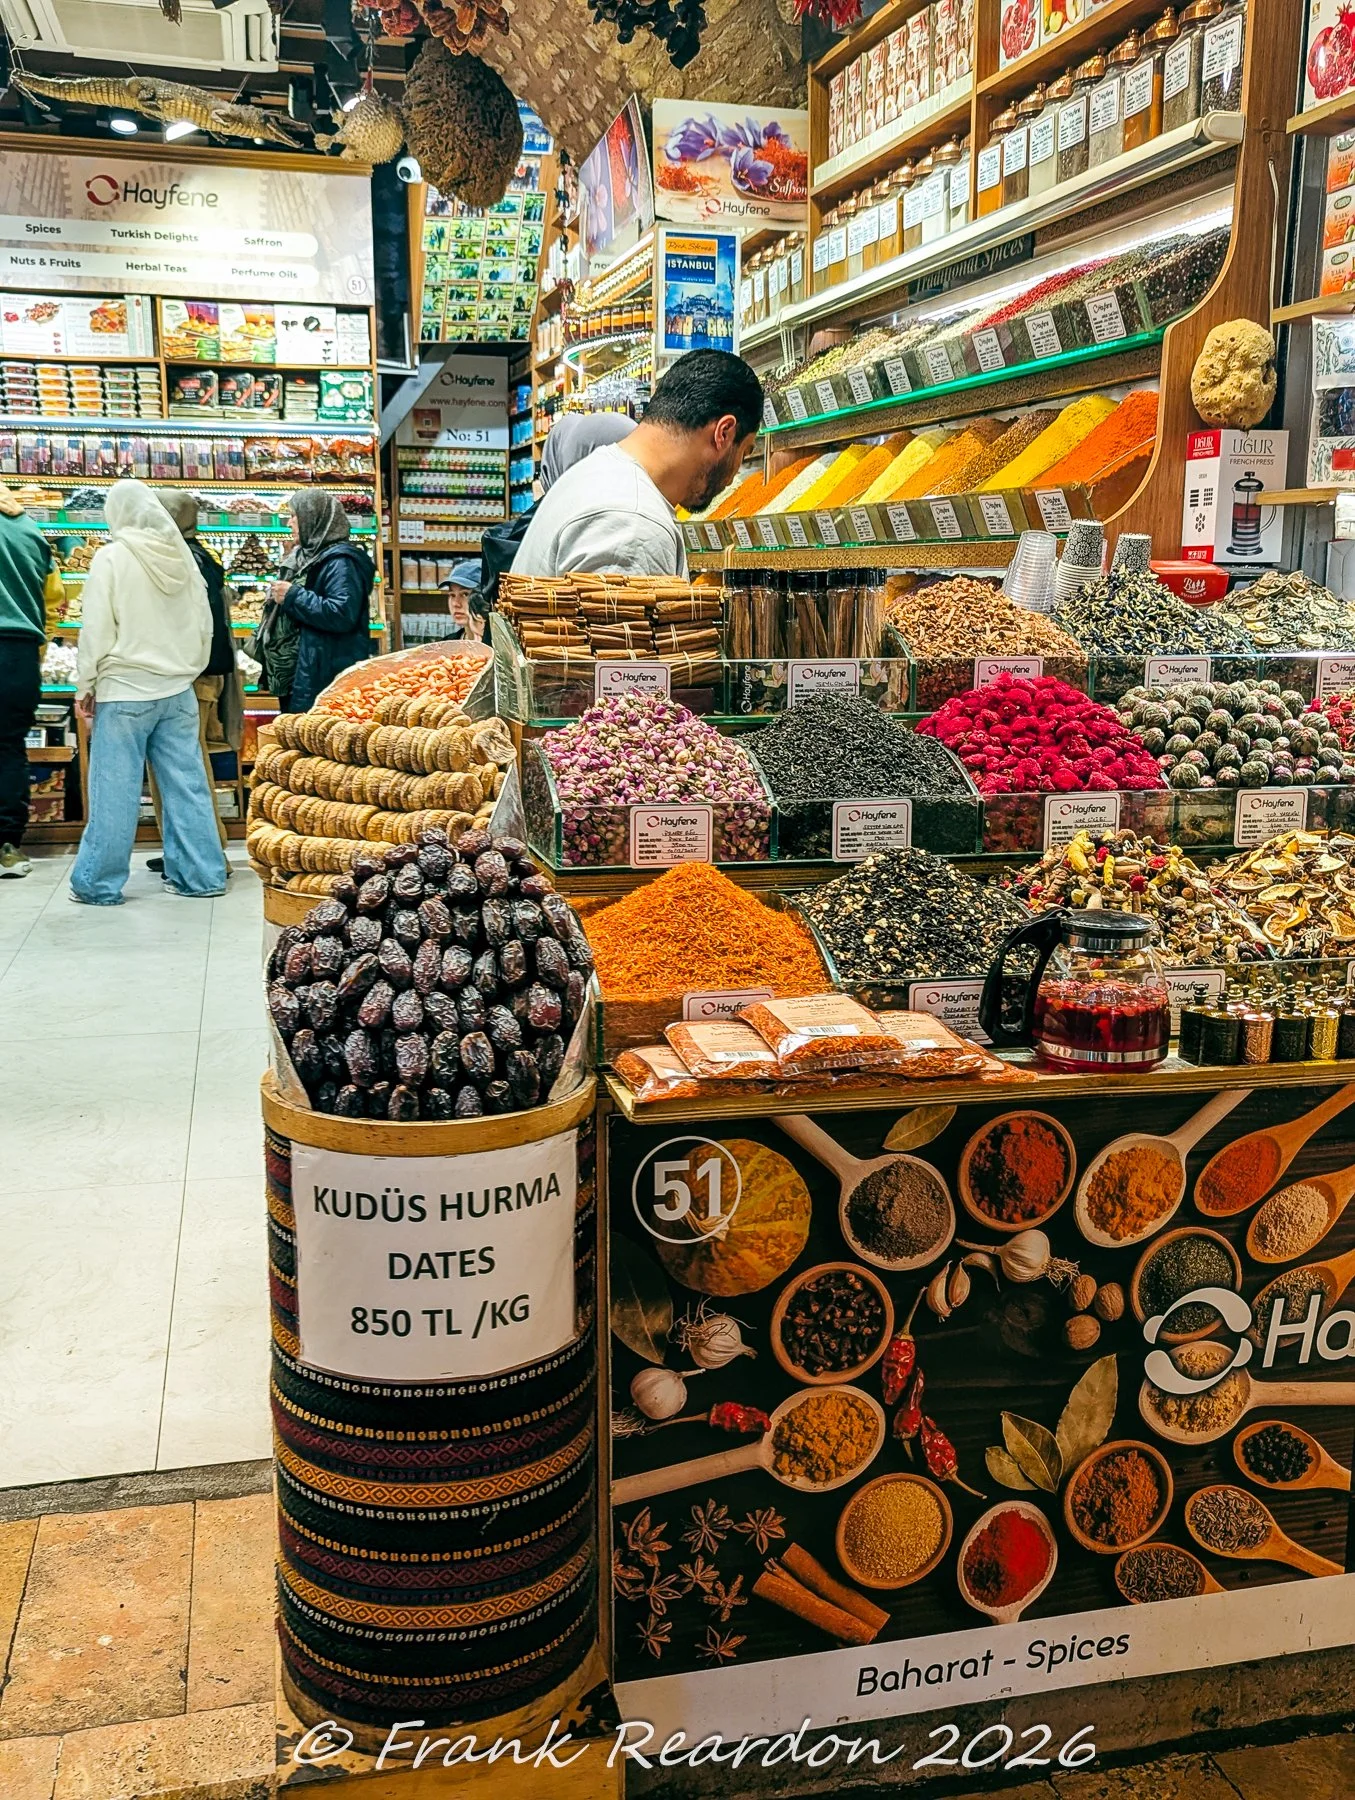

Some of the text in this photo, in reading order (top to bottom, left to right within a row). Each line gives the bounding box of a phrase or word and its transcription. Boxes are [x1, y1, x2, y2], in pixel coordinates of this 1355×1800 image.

[769, 178, 808, 196] Saffron
[123, 182, 218, 210] Hayfene
[723, 201, 771, 218] Hayfene
[25, 223, 62, 235] Spices
[110, 228, 199, 244] Turkish Delights
[243, 236, 283, 248] Saffron
[982, 236, 1025, 272] Spices
[10, 256, 82, 269] Nuts & Fruits
[125, 261, 188, 275] Herbal Teas
[667, 258, 715, 271] ISTANBUL
[231, 266, 298, 280] Perfume Oils
[351, 279, 363, 292] 51
[454, 373, 496, 388] Hayfene
[429, 396, 507, 409] www.hayfene.com
[447, 428, 490, 442] No: 51
[814, 669, 847, 680] Hayfene
[1000, 665, 1030, 675] Hayfene
[1168, 664, 1199, 675] Hayfene
[623, 672, 657, 683] Hayfene
[743, 665, 752, 700] Hayfene
[1072, 804, 1106, 815] Hayfene
[1262, 799, 1295, 809] Hayfene
[660, 816, 698, 828] Hayfene
[861, 810, 897, 822] Hayfene
[941, 992, 980, 1003] Hayfene
[653, 1158, 722, 1221] 51
[314, 1172, 561, 1222] KUDÜS HURMA
[388, 1246, 495, 1280] DATES
[351, 1294, 530, 1339] 850 TL /KG
[856, 1649, 994, 1697] Baharat
[1026, 1633, 1131, 1674] Spices
